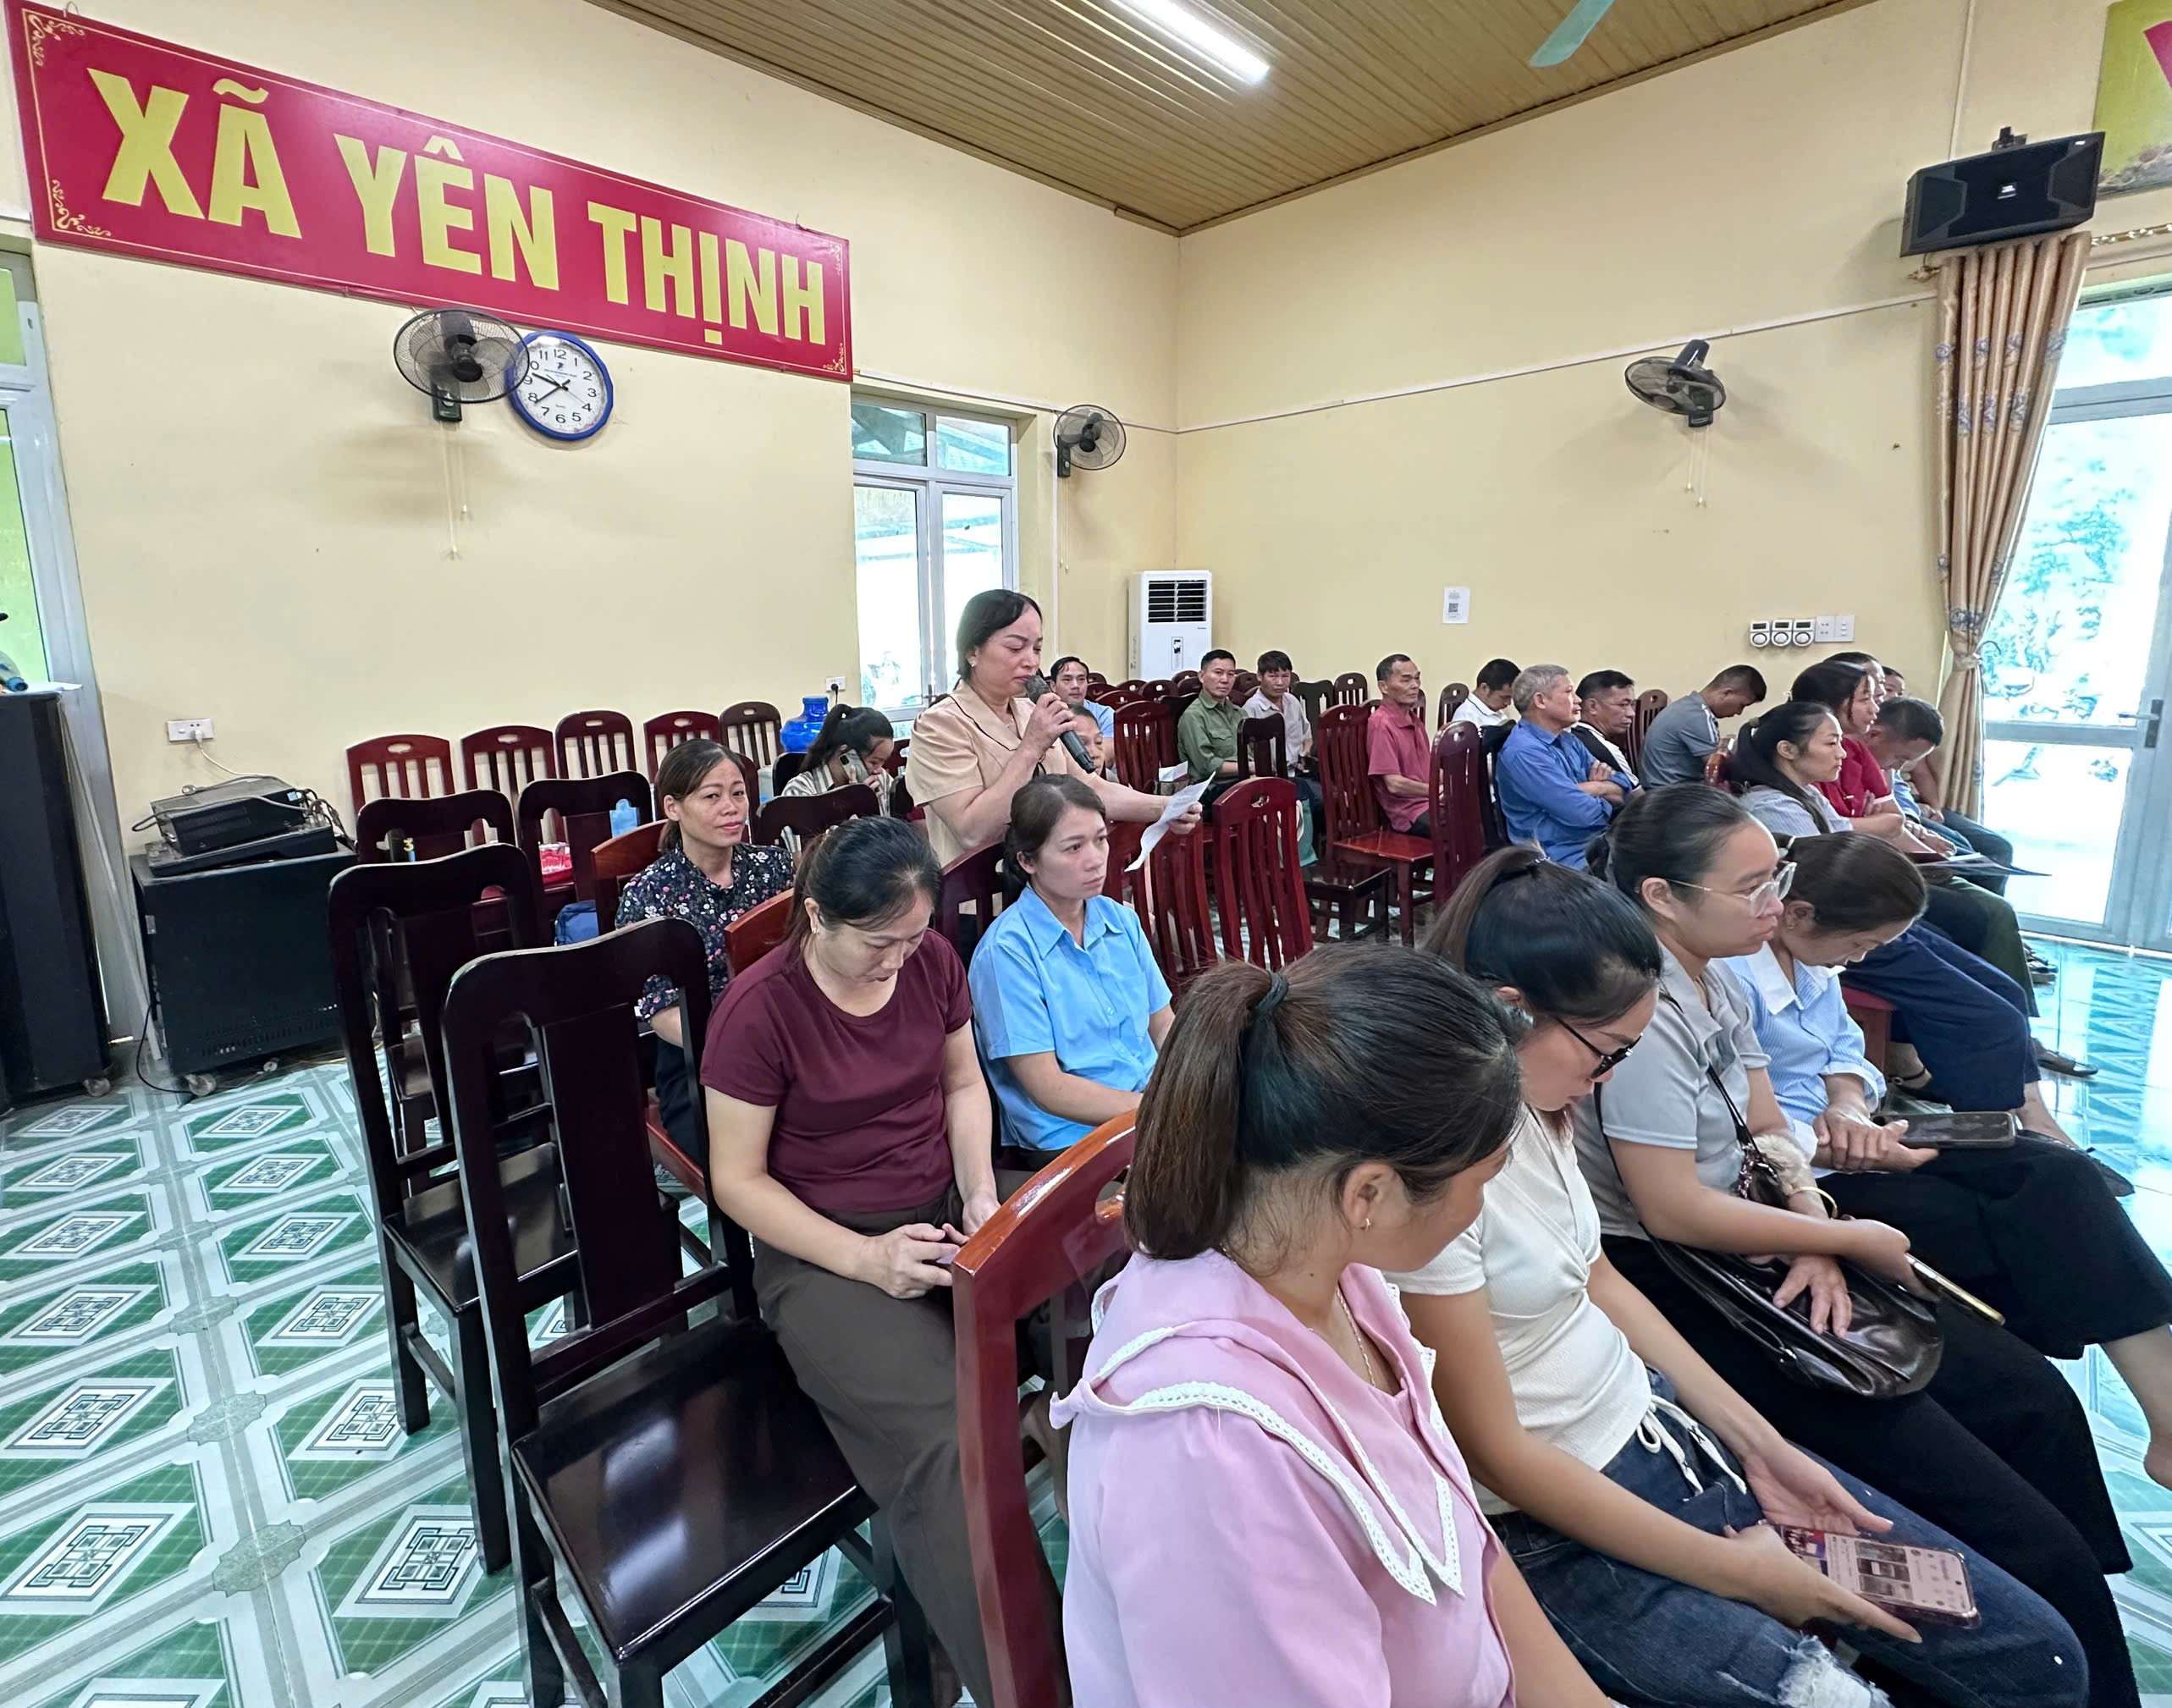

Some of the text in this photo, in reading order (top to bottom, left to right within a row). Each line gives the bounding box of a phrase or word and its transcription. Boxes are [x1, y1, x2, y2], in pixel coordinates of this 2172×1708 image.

[87, 68, 826, 344] XÃ YÊN THỊNH
[539, 350, 548, 361] 11
[554, 349, 566, 360] 12
[574, 357, 578, 366] 1
[524, 376, 532, 385] 9
[583, 371, 592, 381] 2
[587, 388, 597, 397] 3
[528, 392, 537, 403] 8
[541, 406, 549, 416] 7
[582, 403, 592, 412] 4
[555, 414, 565, 423] 6
[572, 412, 582, 421] 5
